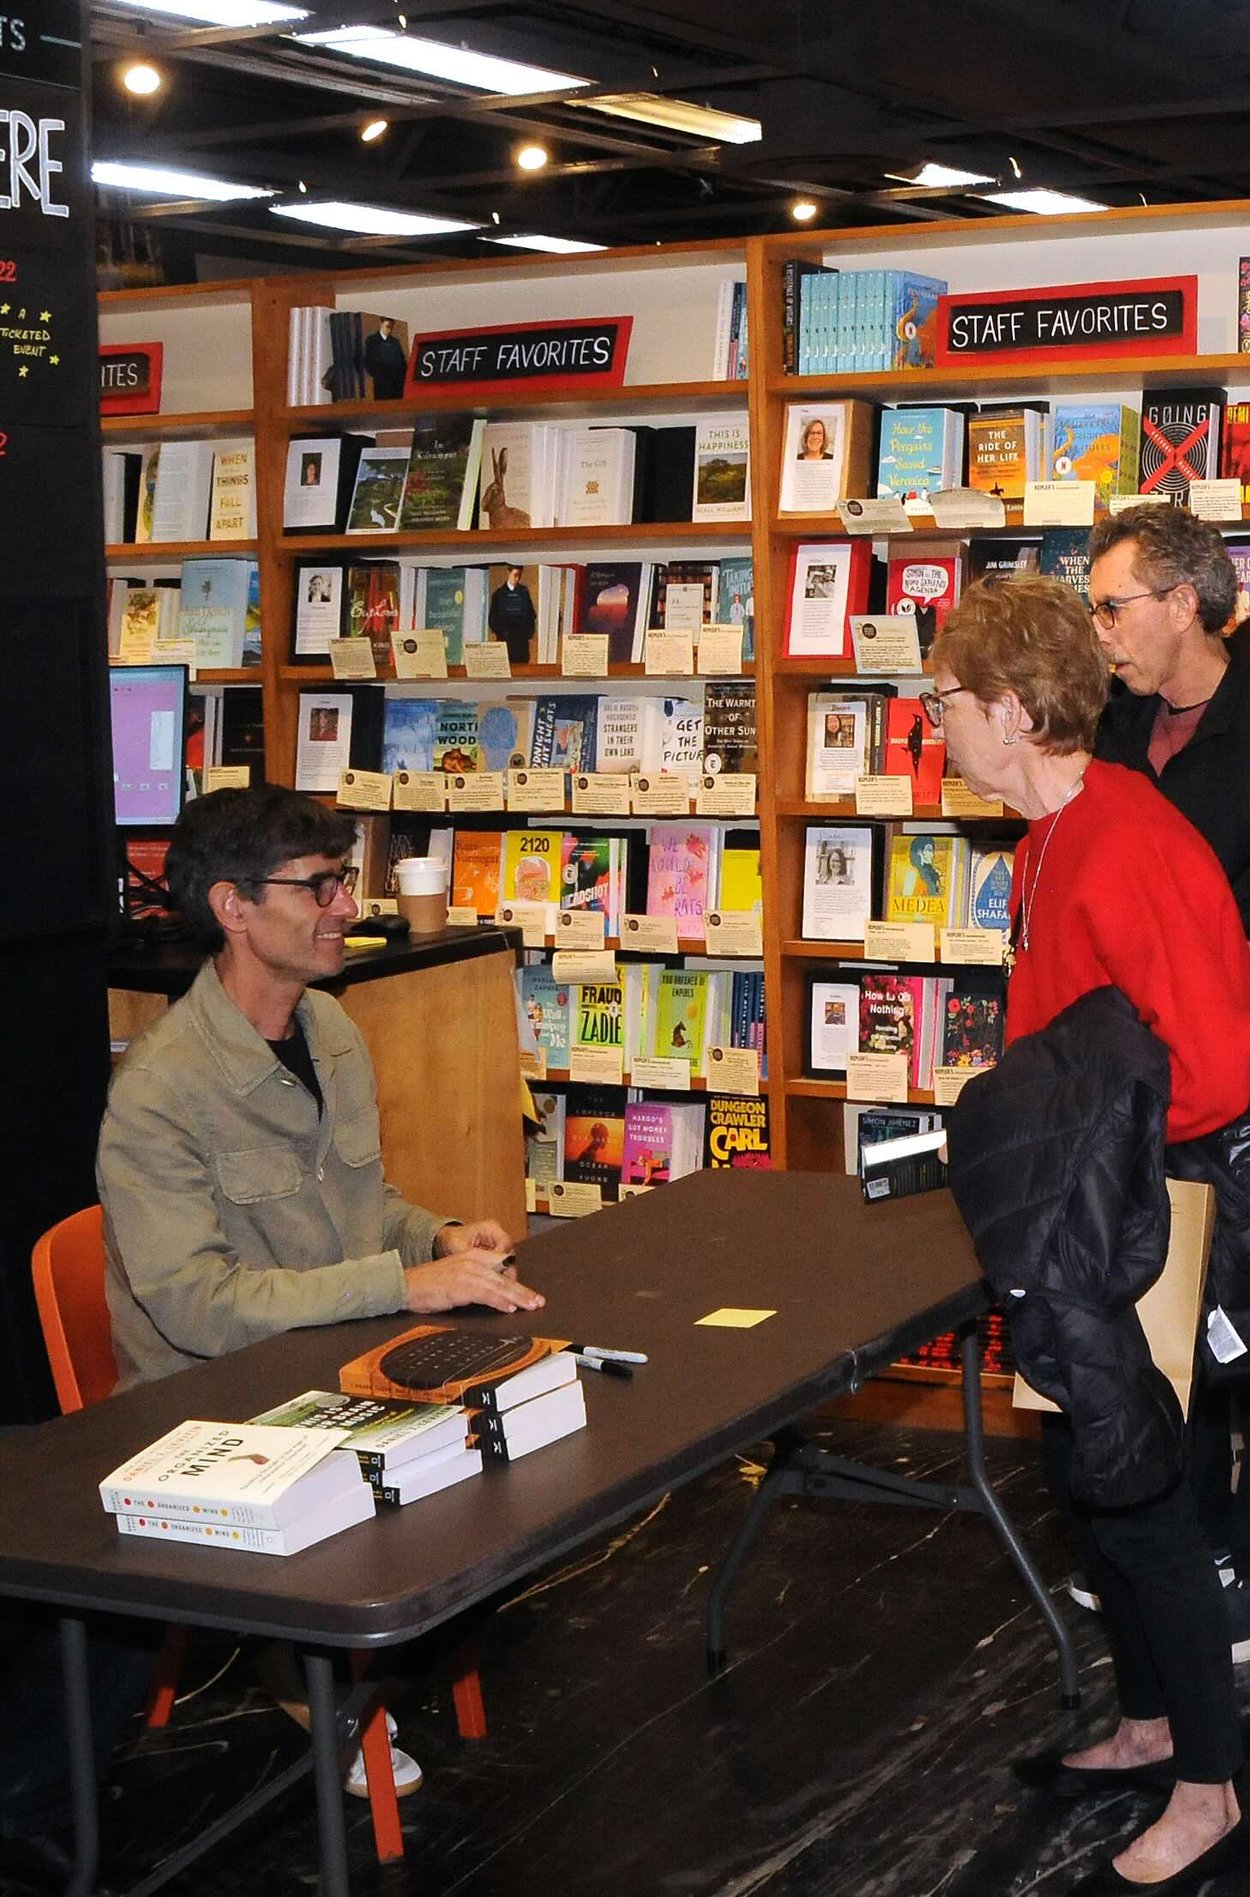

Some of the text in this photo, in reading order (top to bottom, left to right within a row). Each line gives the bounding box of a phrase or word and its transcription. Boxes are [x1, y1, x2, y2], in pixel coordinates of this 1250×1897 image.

[18, 308, 27, 319] A
[952, 302, 1168, 348] STAFF FAVORITES
[13, 344, 47, 357] EVENT
[420, 336, 611, 377] STAFF FAVORITES
[1149, 404, 1208, 426] GOING
[708, 428, 741, 440] THIS IS
[988, 430, 1007, 440] THE
[698, 439, 749, 451] HAPPINESS
[978, 440, 1018, 452] RIDE OF
[220, 453, 248, 467] WHEN
[977, 452, 1019, 463] HER LIFE
[216, 474, 249, 488] THINGS
[219, 495, 242, 508] FALL
[215, 517, 244, 531] APART
[985, 560, 1028, 569] JIM GRIMSLEY
[1060, 556, 1090, 566] WHEN
[1065, 565, 1084, 575] THE
[910, 585, 938, 594] AGENDA
[707, 698, 756, 708] THE WARMT
[728, 713, 740, 721] OF
[603, 723, 638, 733] STRANGERS
[676, 719, 702, 732] GET
[704, 725, 756, 735] OTHER SUN
[438, 735, 477, 746] WOOD
[607, 736, 633, 745] IN THEIR
[677, 737, 698, 748] THE
[604, 748, 635, 757] OWN LAND
[520, 837, 550, 853] 2120
[674, 898, 703, 917] RATS
[893, 898, 945, 913] MEDEA
[988, 898, 1008, 909] ELIF
[581, 986, 623, 1005] FRAUD
[672, 988, 695, 998] EMPIRES
[864, 990, 885, 1000] How
[886, 991, 896, 1001] to
[869, 1004, 905, 1016] Nothing
[581, 1010, 622, 1044] ZADIE
[710, 1099, 766, 1114] DUNGEON
[710, 1112, 767, 1127] CRAWLER
[710, 1126, 768, 1160] CARL
[180, 1437, 245, 1478] MIND
